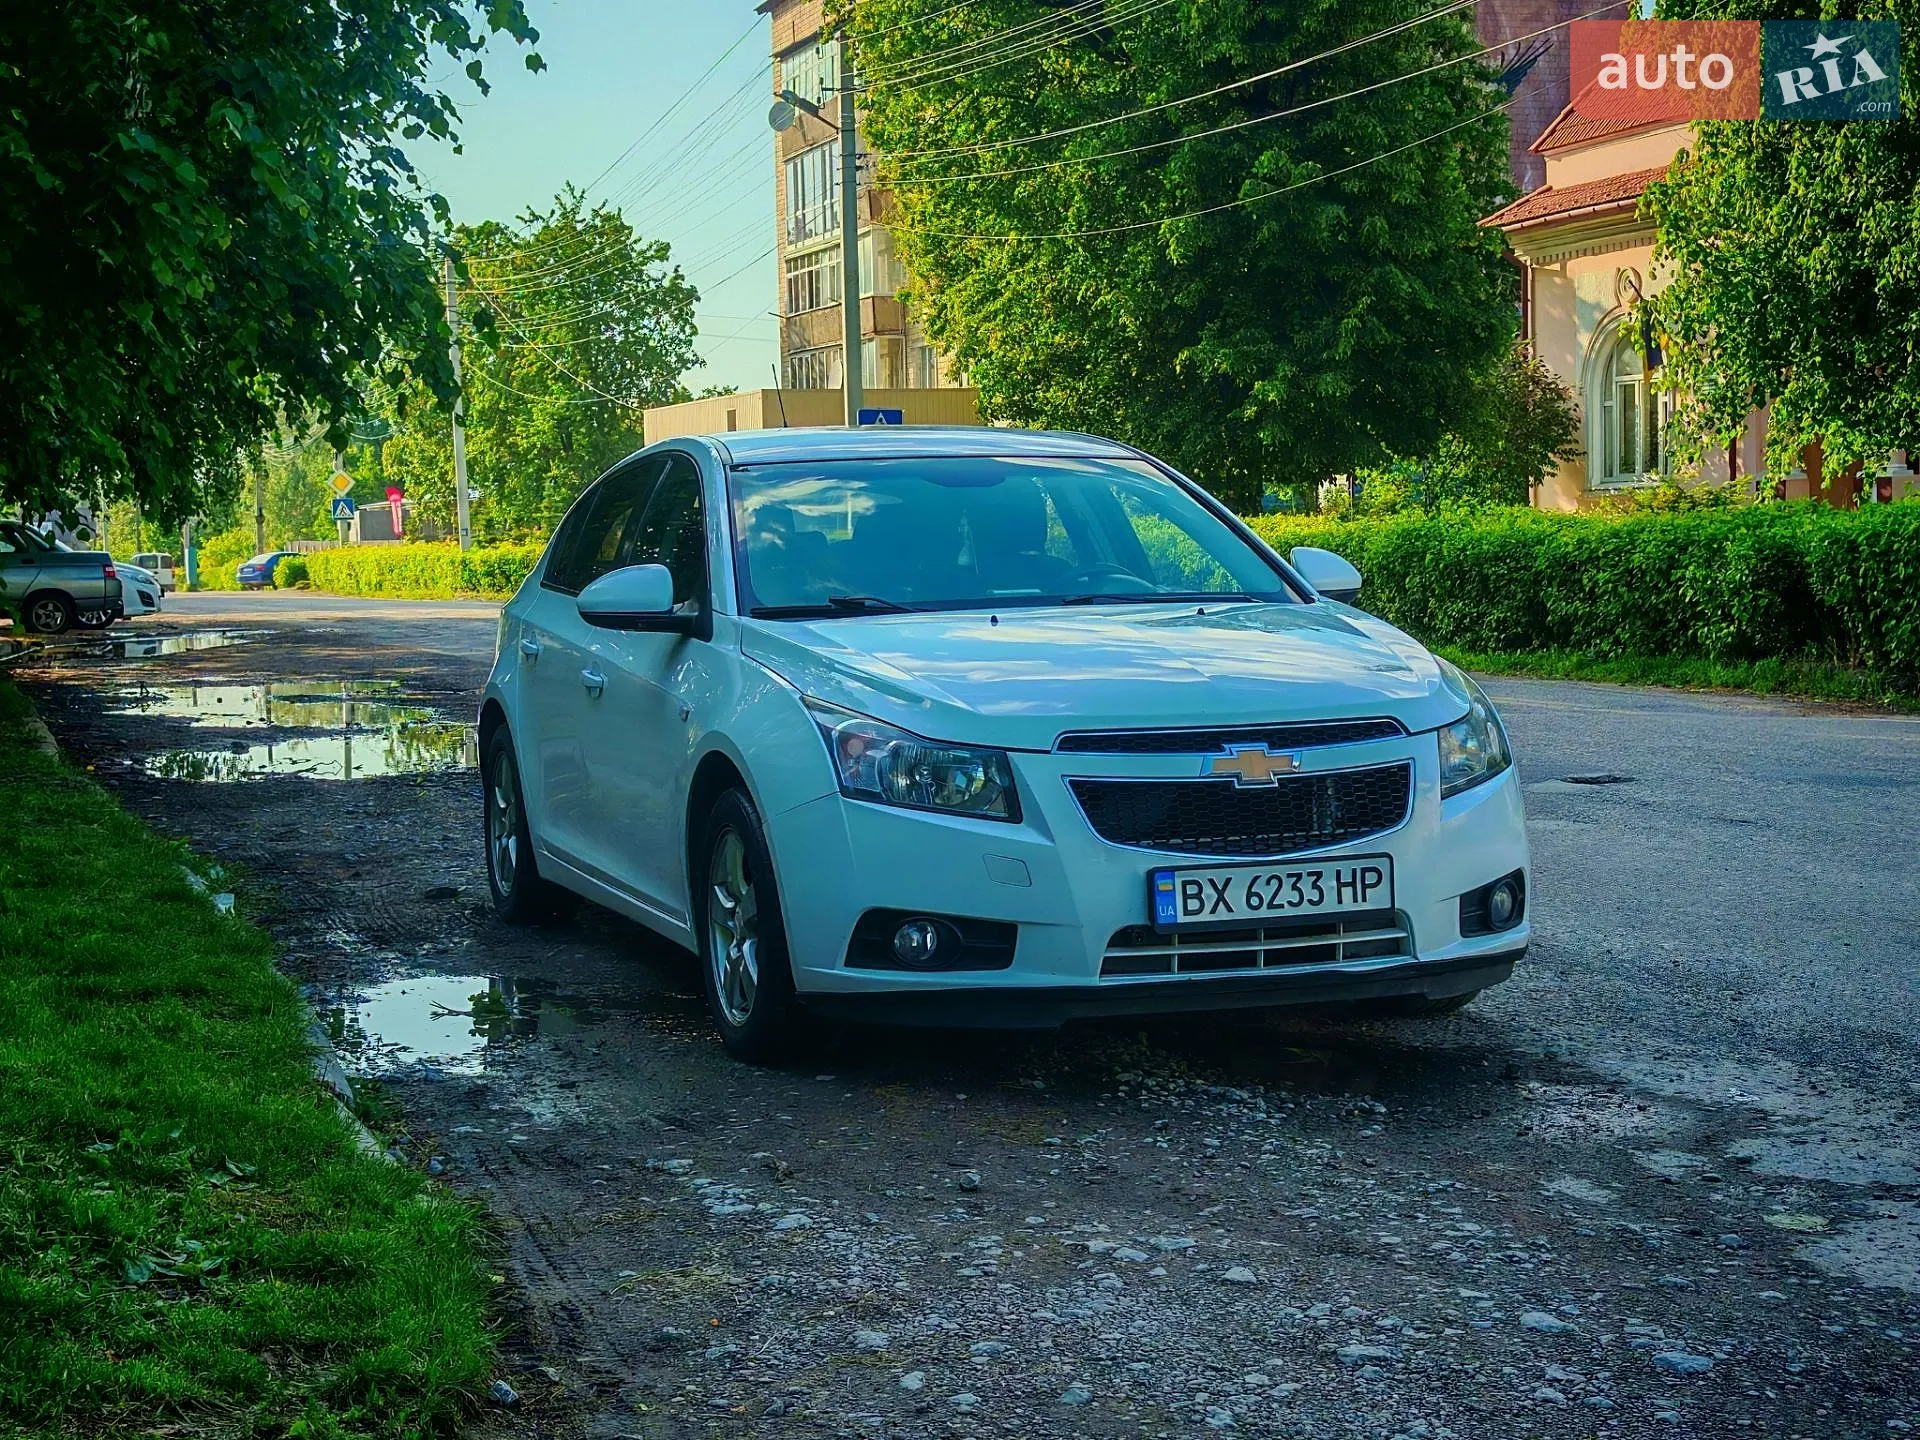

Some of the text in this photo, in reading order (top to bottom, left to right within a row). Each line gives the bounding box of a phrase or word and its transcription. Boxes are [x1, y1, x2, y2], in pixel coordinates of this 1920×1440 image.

[1181, 866, 1383, 916] BX 6233 HP
[1159, 904, 1175, 916] UA
